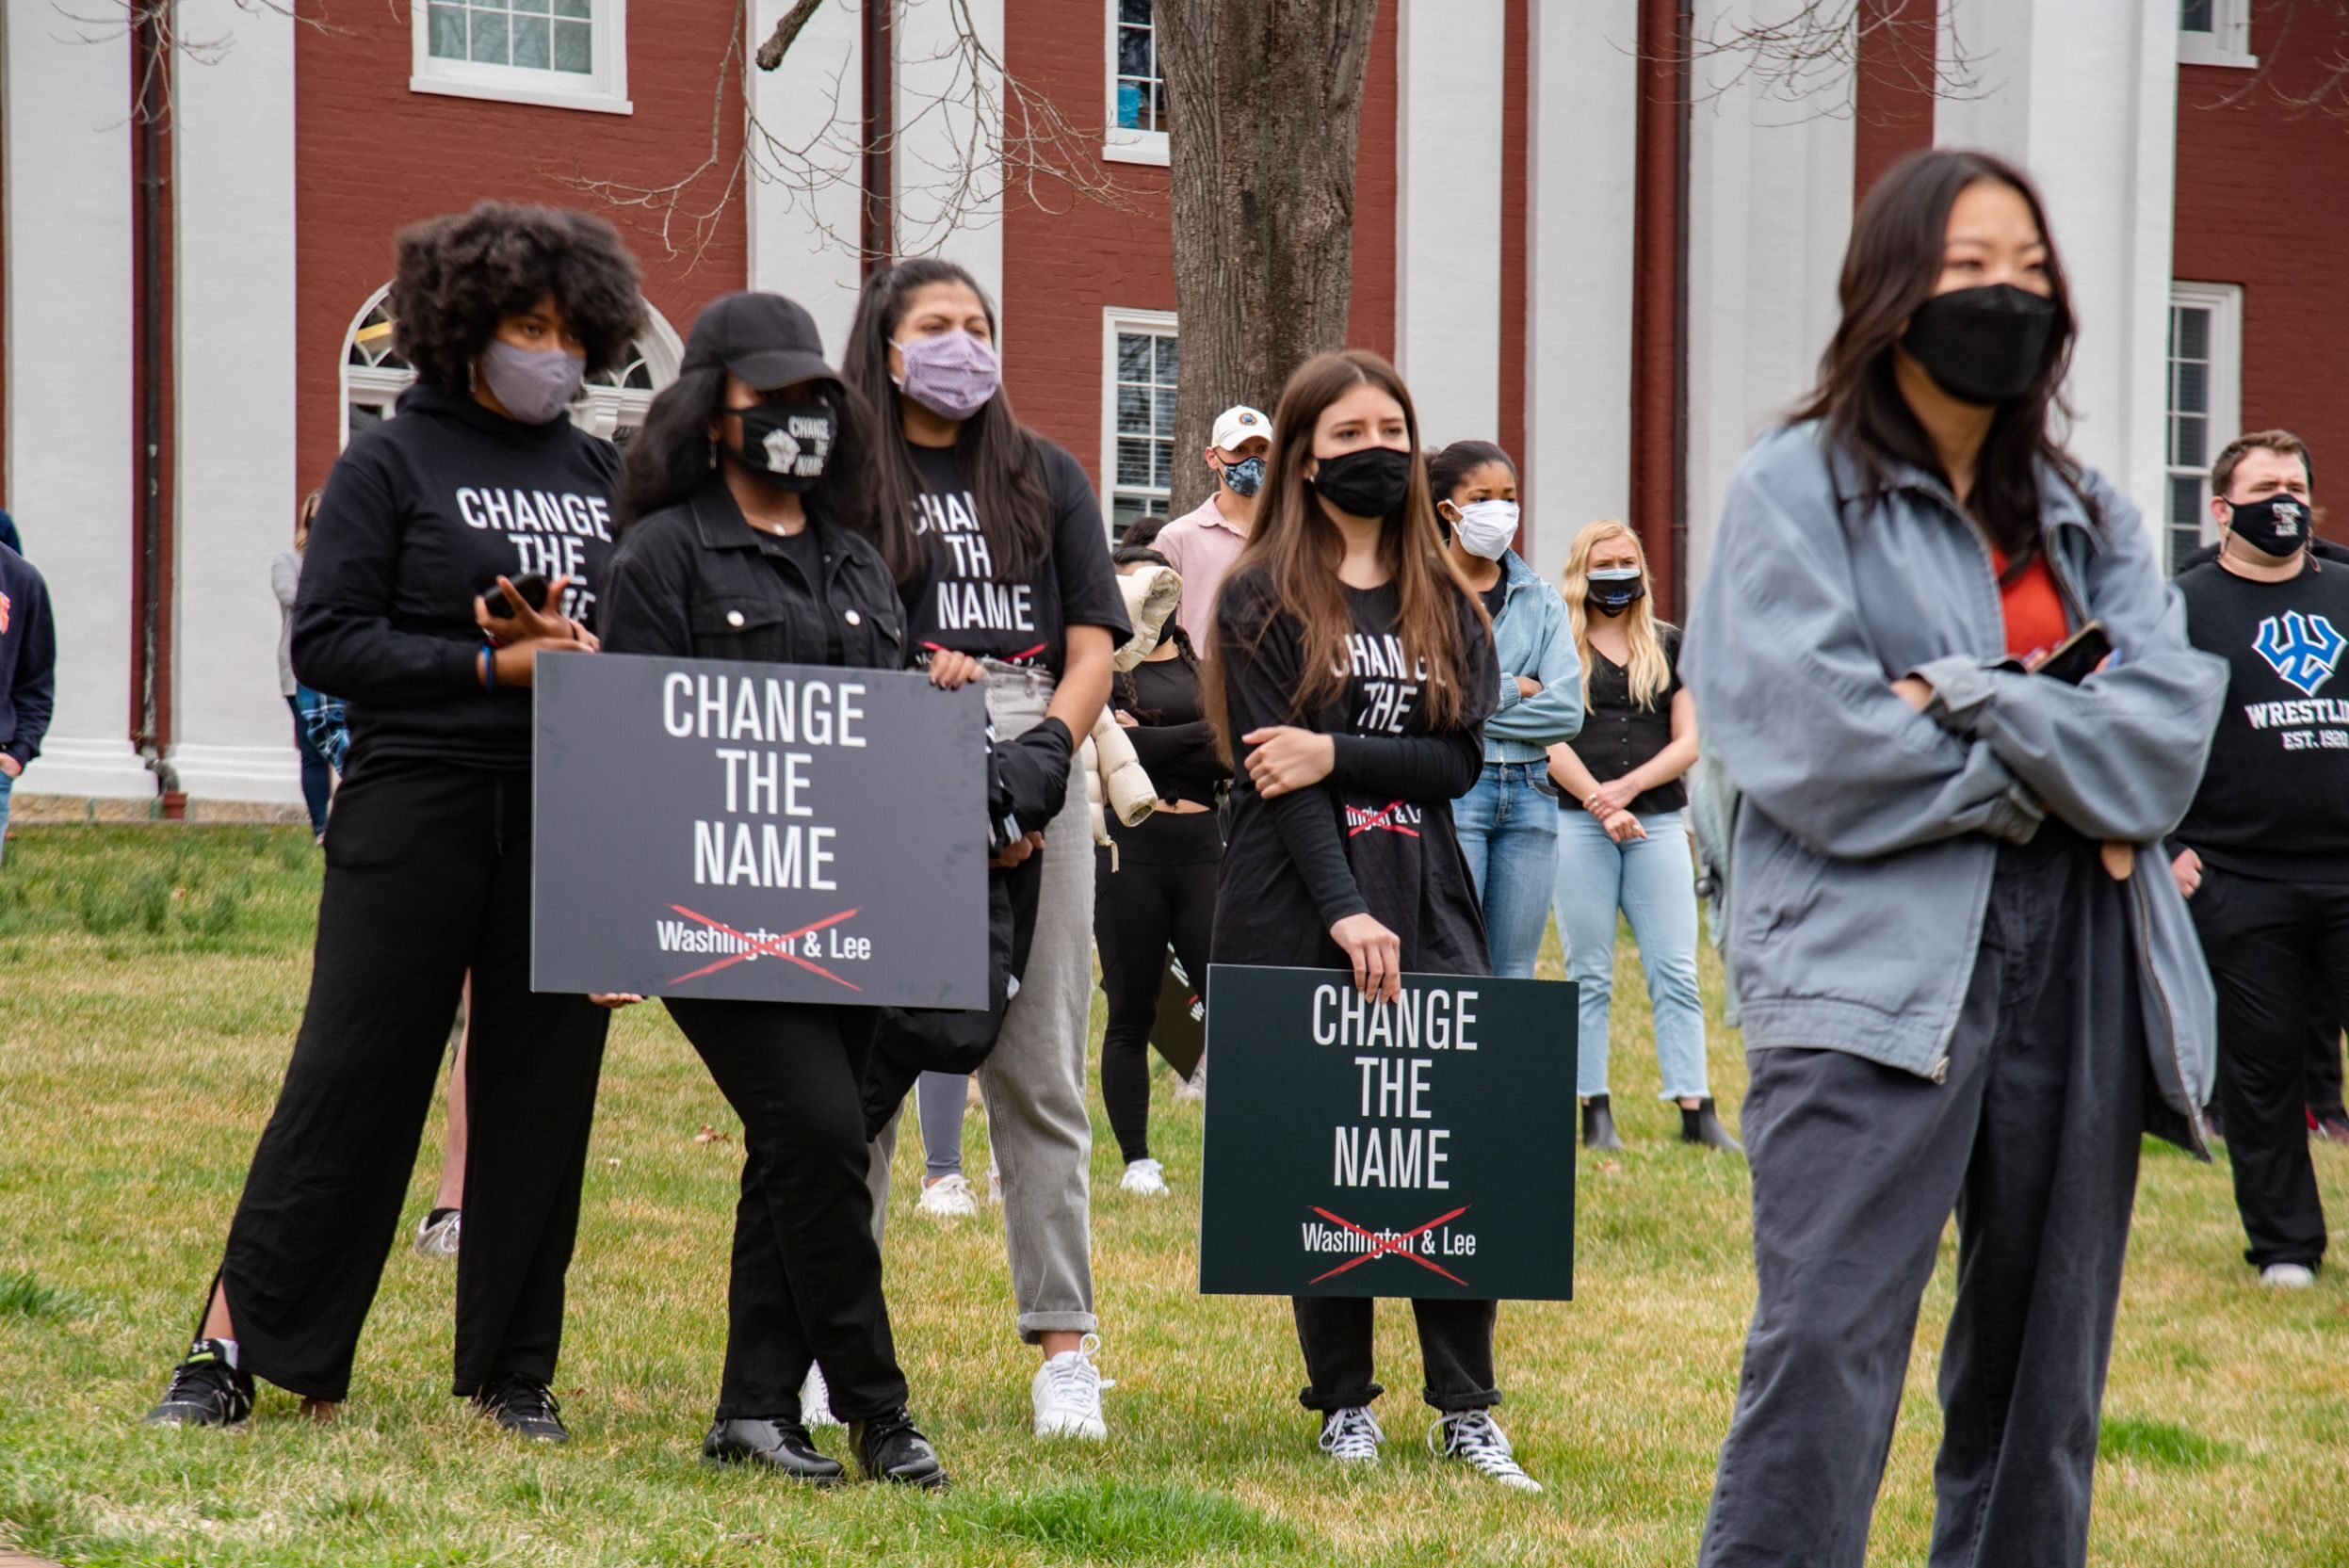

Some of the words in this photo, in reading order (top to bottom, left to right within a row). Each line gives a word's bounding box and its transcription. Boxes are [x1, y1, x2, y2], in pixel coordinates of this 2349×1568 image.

[456, 487, 612, 542] CHANGE
[508, 533, 588, 586] THE
[944, 533, 993, 578] TH
[937, 581, 1035, 631] NAME
[663, 671, 867, 748] CHANGE
[1356, 681, 1418, 734] THE
[2244, 698, 2349, 730] WRESTLI
[2281, 730, 2320, 751] EST.
[716, 748, 813, 816] THE
[1394, 804, 1408, 824] &
[694, 820, 836, 891] NAME
[656, 919, 795, 961] Washington
[803, 930, 822, 958] &
[830, 929, 871, 960] Lee
[1312, 984, 1479, 1051] CHANGE
[1354, 1057, 1433, 1119] THE
[1334, 1125, 1450, 1189] NAME
[1302, 1222, 1414, 1259] Washington
[1420, 1229, 1435, 1254] &
[1443, 1226, 1476, 1255] Lee
